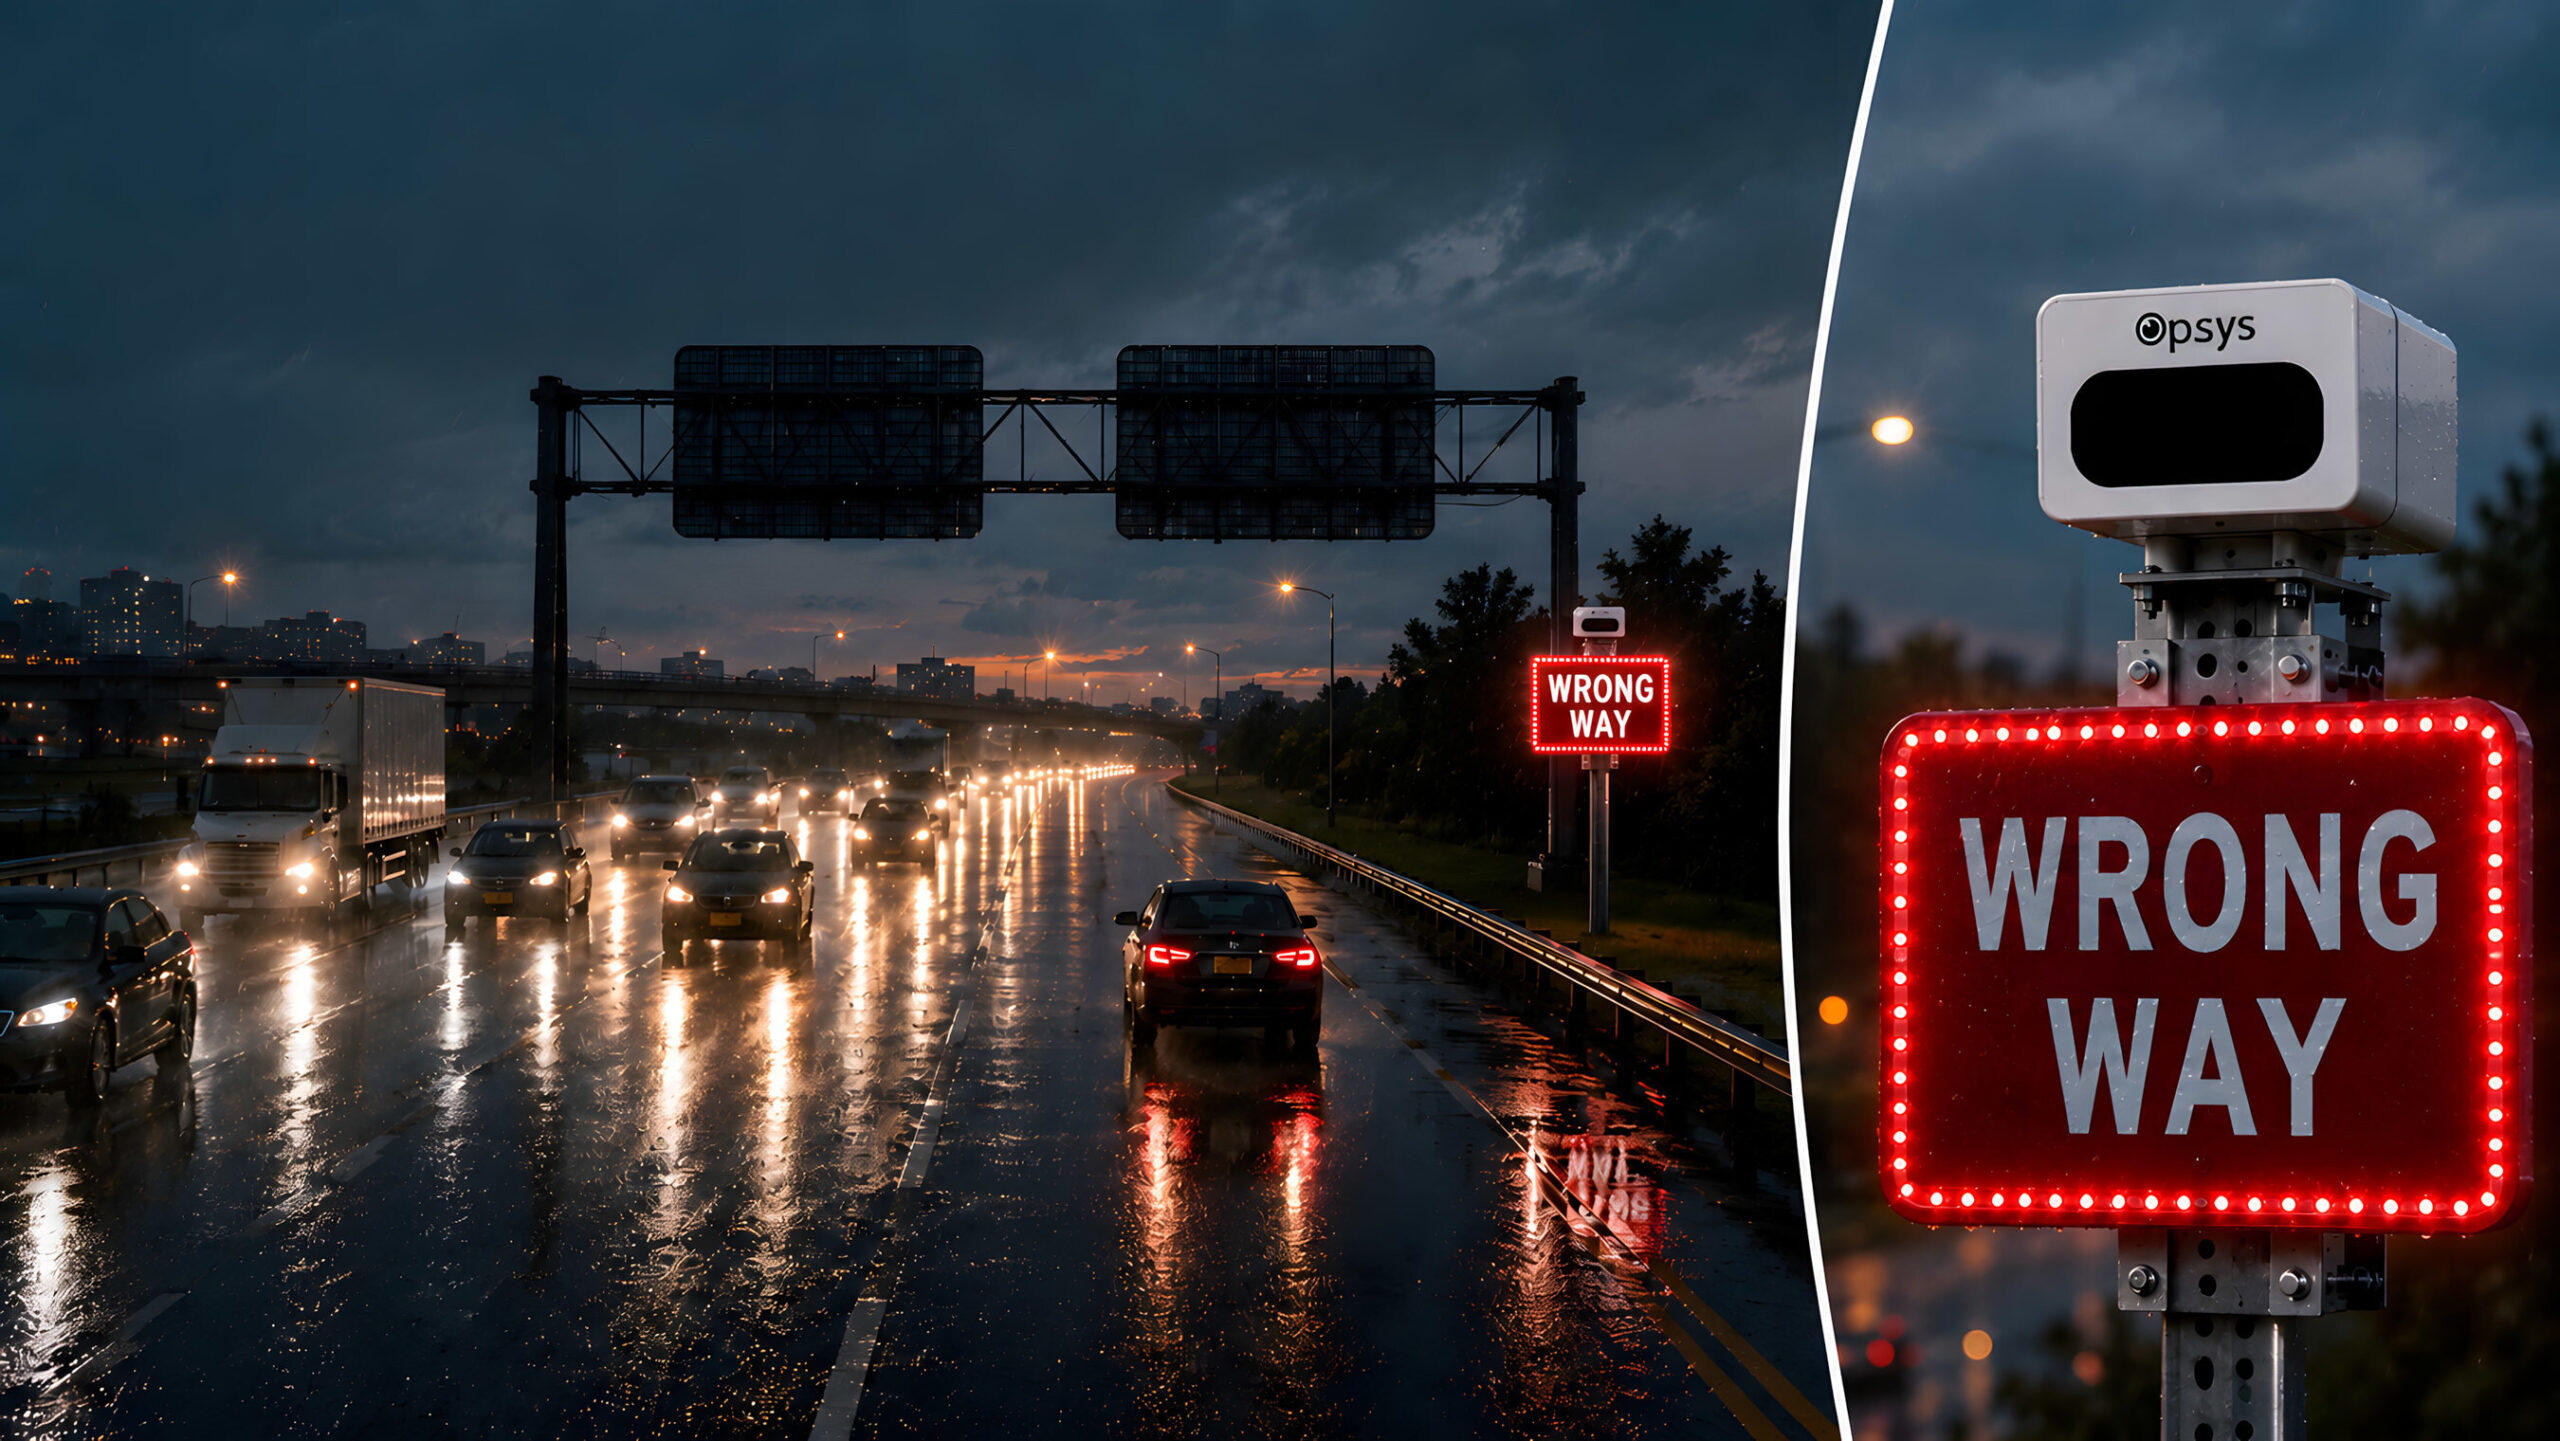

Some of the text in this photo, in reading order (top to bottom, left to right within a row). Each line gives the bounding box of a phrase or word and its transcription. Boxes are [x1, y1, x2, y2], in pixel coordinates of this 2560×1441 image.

[2135, 312, 2256, 353] Opsys
[1547, 673, 1654, 704] WRONG
[1569, 709, 1632, 739] WAY
[1959, 809, 2438, 954] WRONG
[2046, 997, 2347, 1137] WAY
